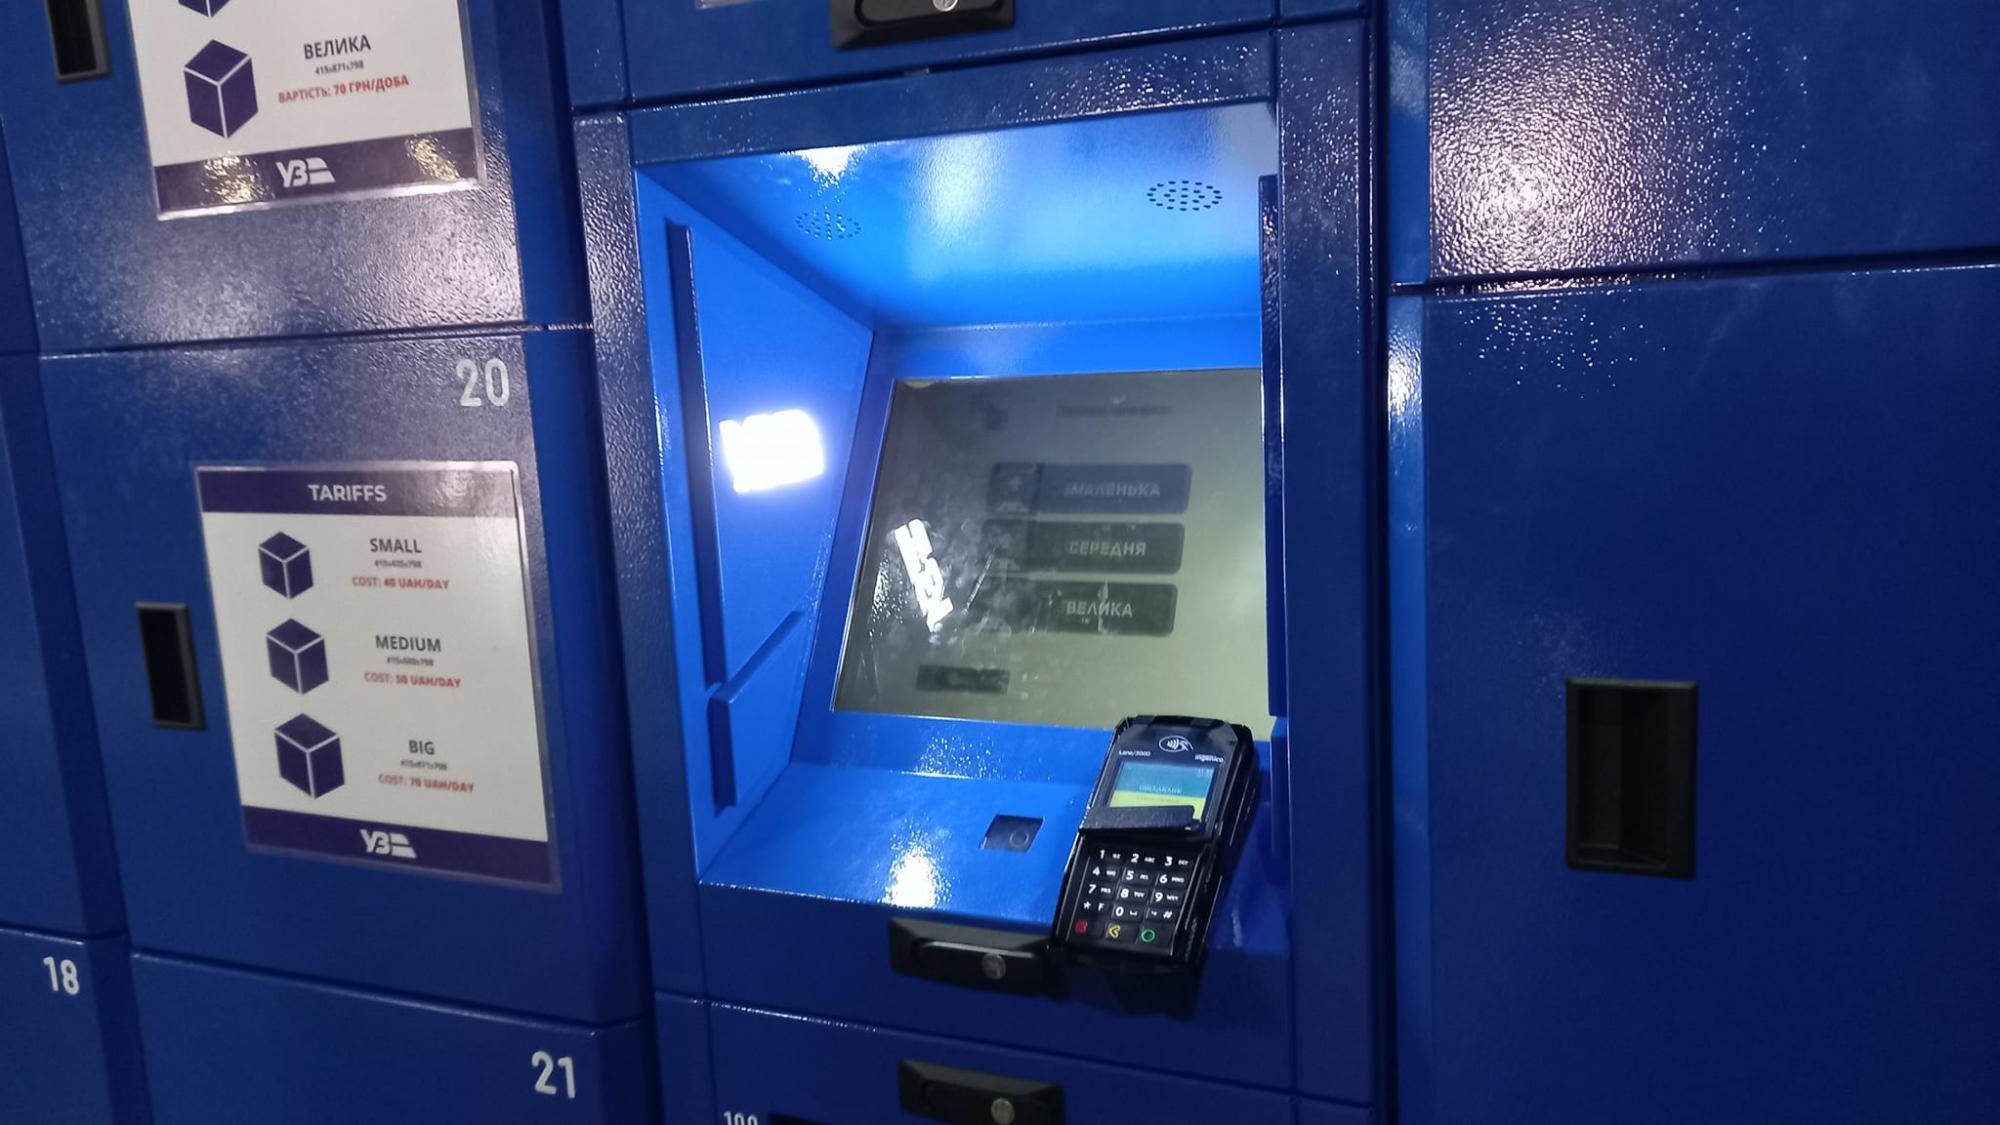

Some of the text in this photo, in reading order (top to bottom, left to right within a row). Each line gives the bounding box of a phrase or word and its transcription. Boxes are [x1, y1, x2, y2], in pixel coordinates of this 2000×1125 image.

[303, 34, 372, 60] ВЕЛИКА
[277, 74, 410, 104] ВАРТІСТЬ: 70 ГРН/ДОБА
[455, 358, 510, 407] 20
[307, 483, 388, 502] TARIFFS
[369, 538, 423, 554] SMALL
[1069, 540, 1147, 557] СЕРЕДНЯ
[351, 575, 381, 588] COST:
[398, 578, 449, 591] UAH/DAY
[1066, 600, 1133, 617] ВЕЛИКА
[375, 634, 442, 653] MEDIUM
[363, 671, 394, 684] COST:
[410, 675, 462, 689] UAH/DAY
[408, 739, 436, 756] BIG
[377, 773, 407, 787] COST:
[424, 778, 475, 794] UAH/DAY
[1099, 848, 1106, 861] 1
[1130, 852, 1140, 864] 2
[1164, 855, 1173, 867] 3
[1092, 865, 1101, 877] 4
[1125, 869, 1135, 881] 5
[1159, 873, 1168, 884] 6
[1088, 883, 1097, 895] 7
[1120, 888, 1130, 899] 8
[1155, 892, 1164, 903] 9
[1115, 906, 1125, 917] 0
[42, 956, 80, 996] 18
[531, 1050, 576, 1099] 21
